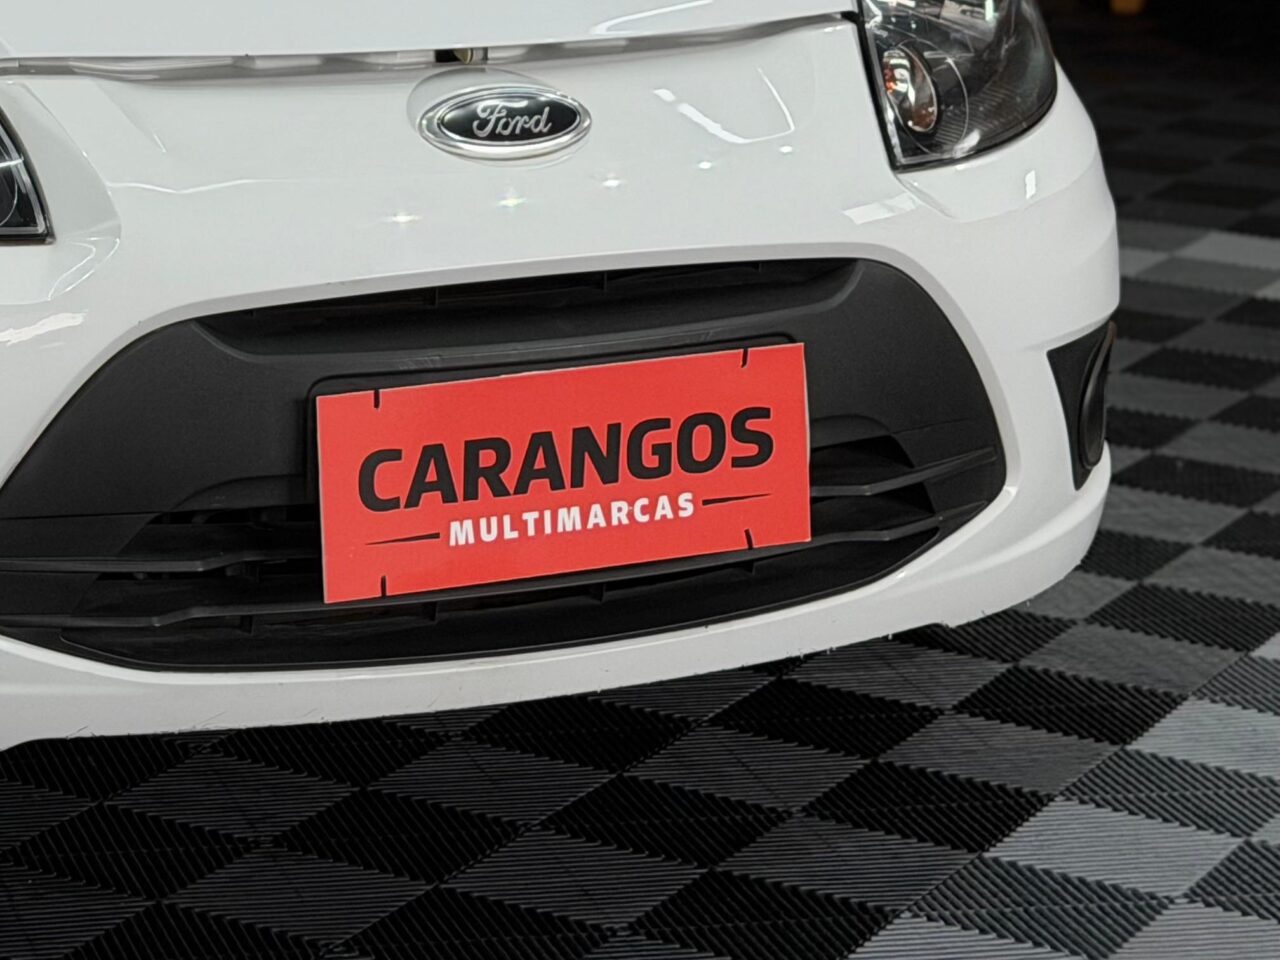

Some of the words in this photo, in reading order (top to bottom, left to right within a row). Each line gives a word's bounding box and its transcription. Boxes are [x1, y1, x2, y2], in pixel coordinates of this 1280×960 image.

[472, 98, 553, 138] Ford
[358, 406, 775, 512] CARANGOS
[448, 492, 695, 547] MULTIMARCAS
